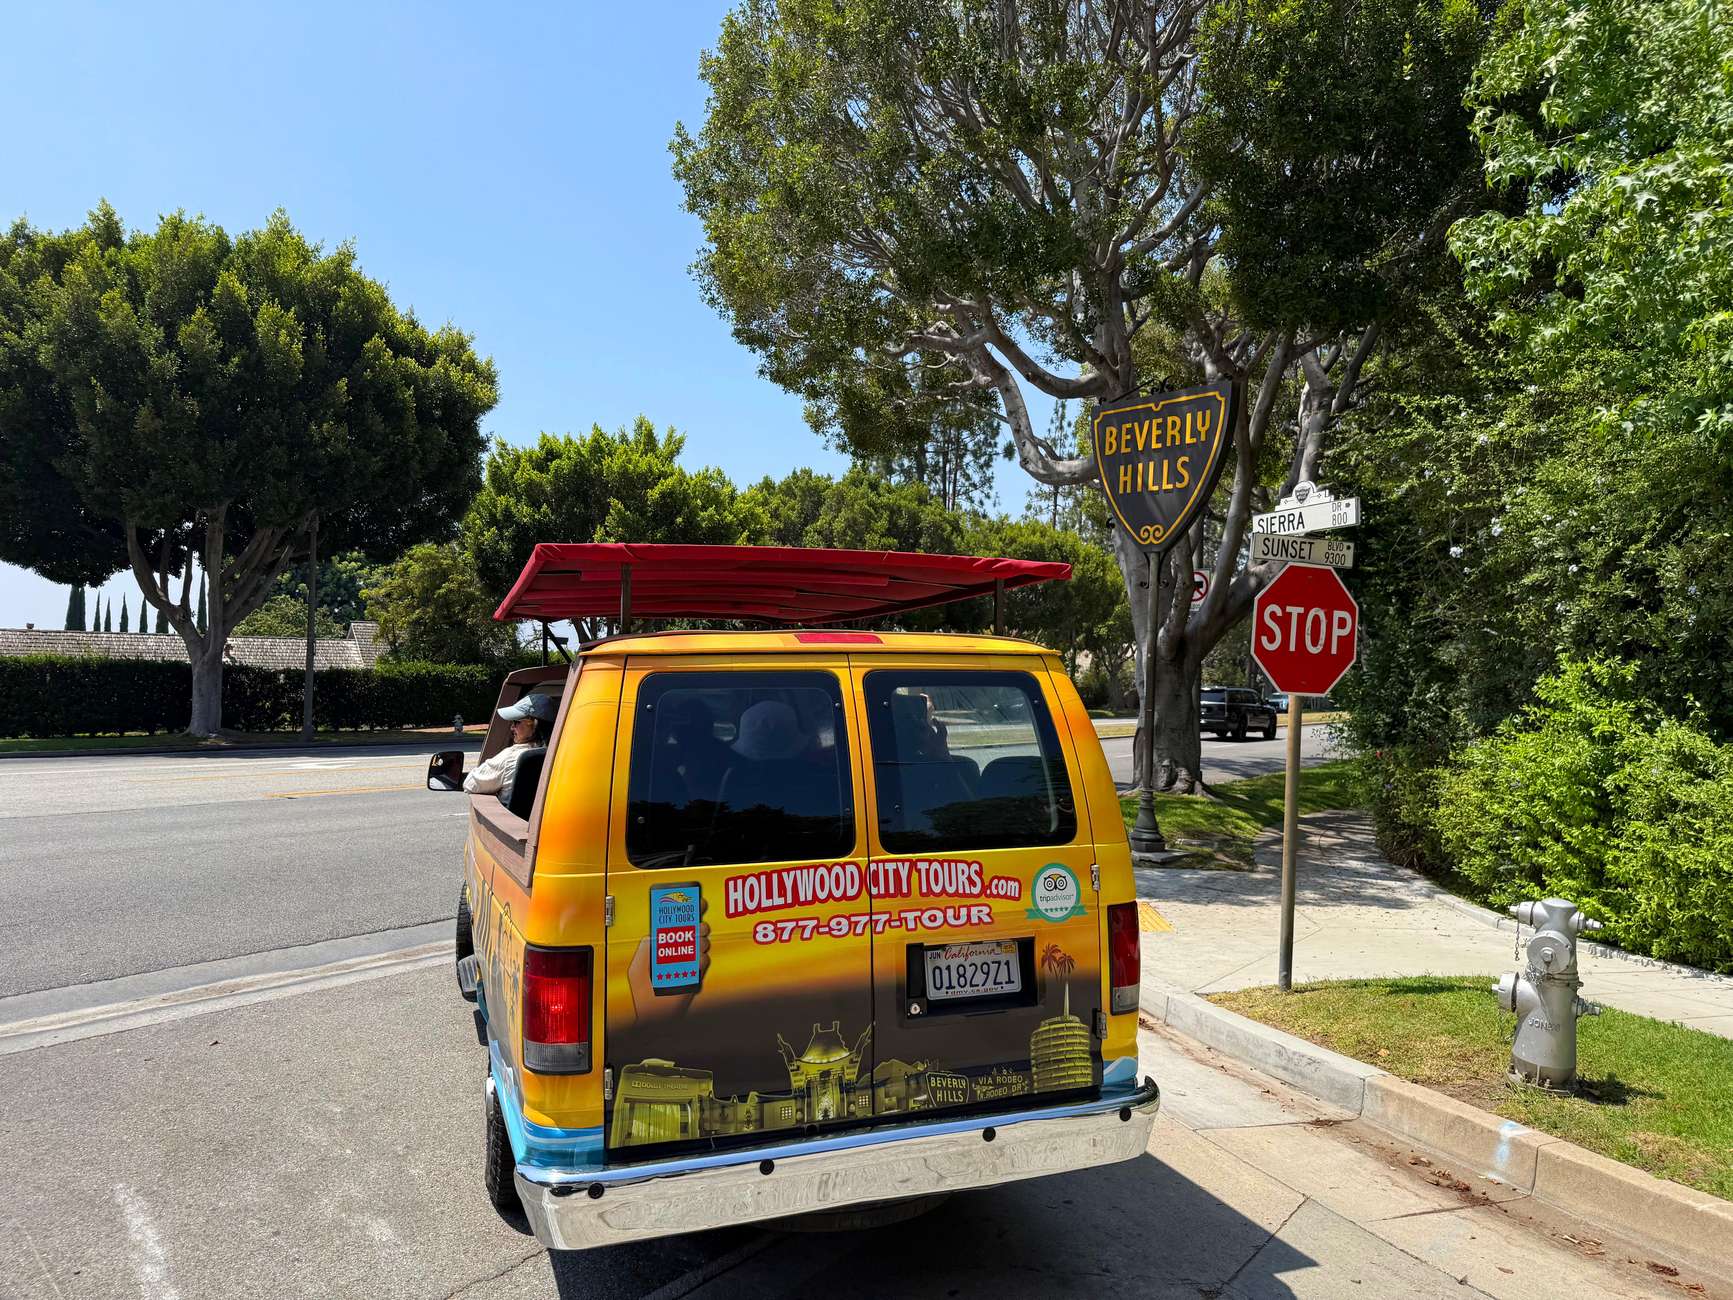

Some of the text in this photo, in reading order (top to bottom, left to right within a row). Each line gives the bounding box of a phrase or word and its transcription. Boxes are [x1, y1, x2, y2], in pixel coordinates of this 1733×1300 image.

[1104, 408, 1211, 456] BEVERLY
[1118, 456, 1190, 495] HILLS
[1257, 501, 1342, 535] SIERRA DR
[1331, 512, 1348, 526] 800
[1261, 537, 1344, 560] SUNSET BLVD
[1324, 551, 1346, 565] 9300
[1260, 603, 1352, 655] STOP
[728, 864, 860, 914] HOLLYWOOD
[868, 861, 910, 896] CITY
[916, 861, 982, 897] TOURS
[658, 904, 695, 915] HOLLYWOOD
[658, 913, 695, 925] CITY TOURS
[755, 905, 992, 942] 877-977-TOUR
[658, 930, 695, 944] BOOK
[658, 945, 695, 957] ONLINE
[929, 951, 941, 960] JUN
[943, 944, 1000, 961] California
[930, 1077, 966, 1089] BEVERLY
[978, 1074, 1023, 1085] VIA RODEO
[936, 1090, 964, 1102] HILLS
